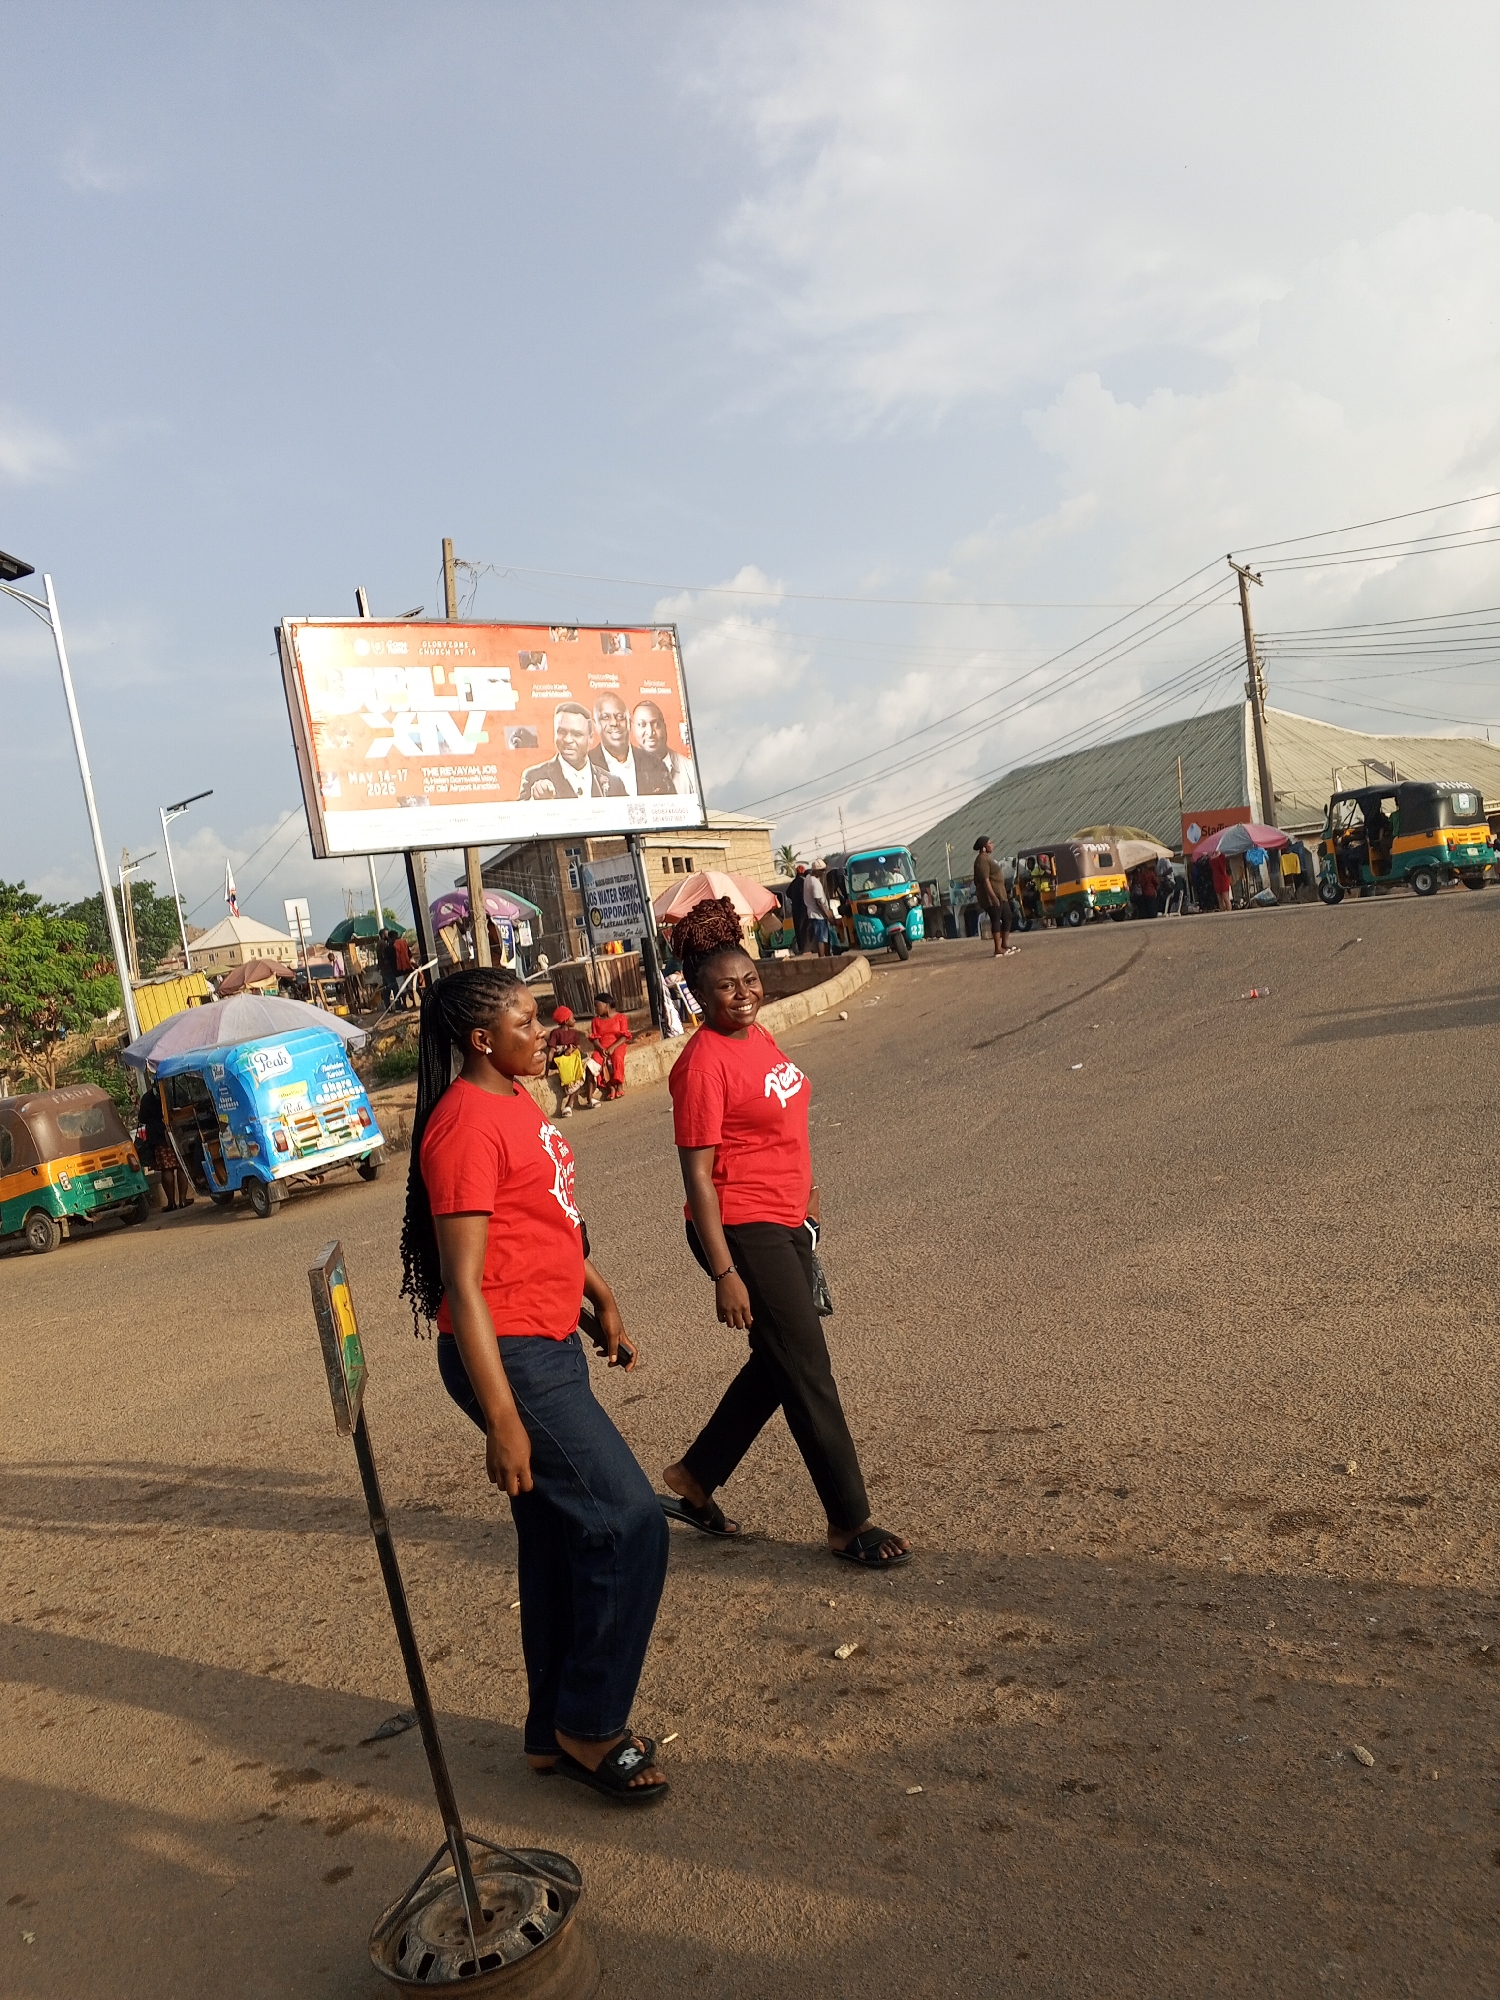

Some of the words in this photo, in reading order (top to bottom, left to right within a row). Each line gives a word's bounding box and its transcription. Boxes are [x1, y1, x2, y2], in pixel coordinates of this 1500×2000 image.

[418, 648, 451, 656] CHURCH
[347, 771, 373, 784] MAY
[378, 769, 408, 783] 14-17
[421, 767, 439, 777] THE
[482, 765, 497, 775] JOS
[366, 782, 396, 797] 2026
[586, 891, 598, 907] JOS
[597, 887, 619, 905] WATER
[618, 884, 639, 902] SERVIC
[253, 1051, 288, 1073] Peak
